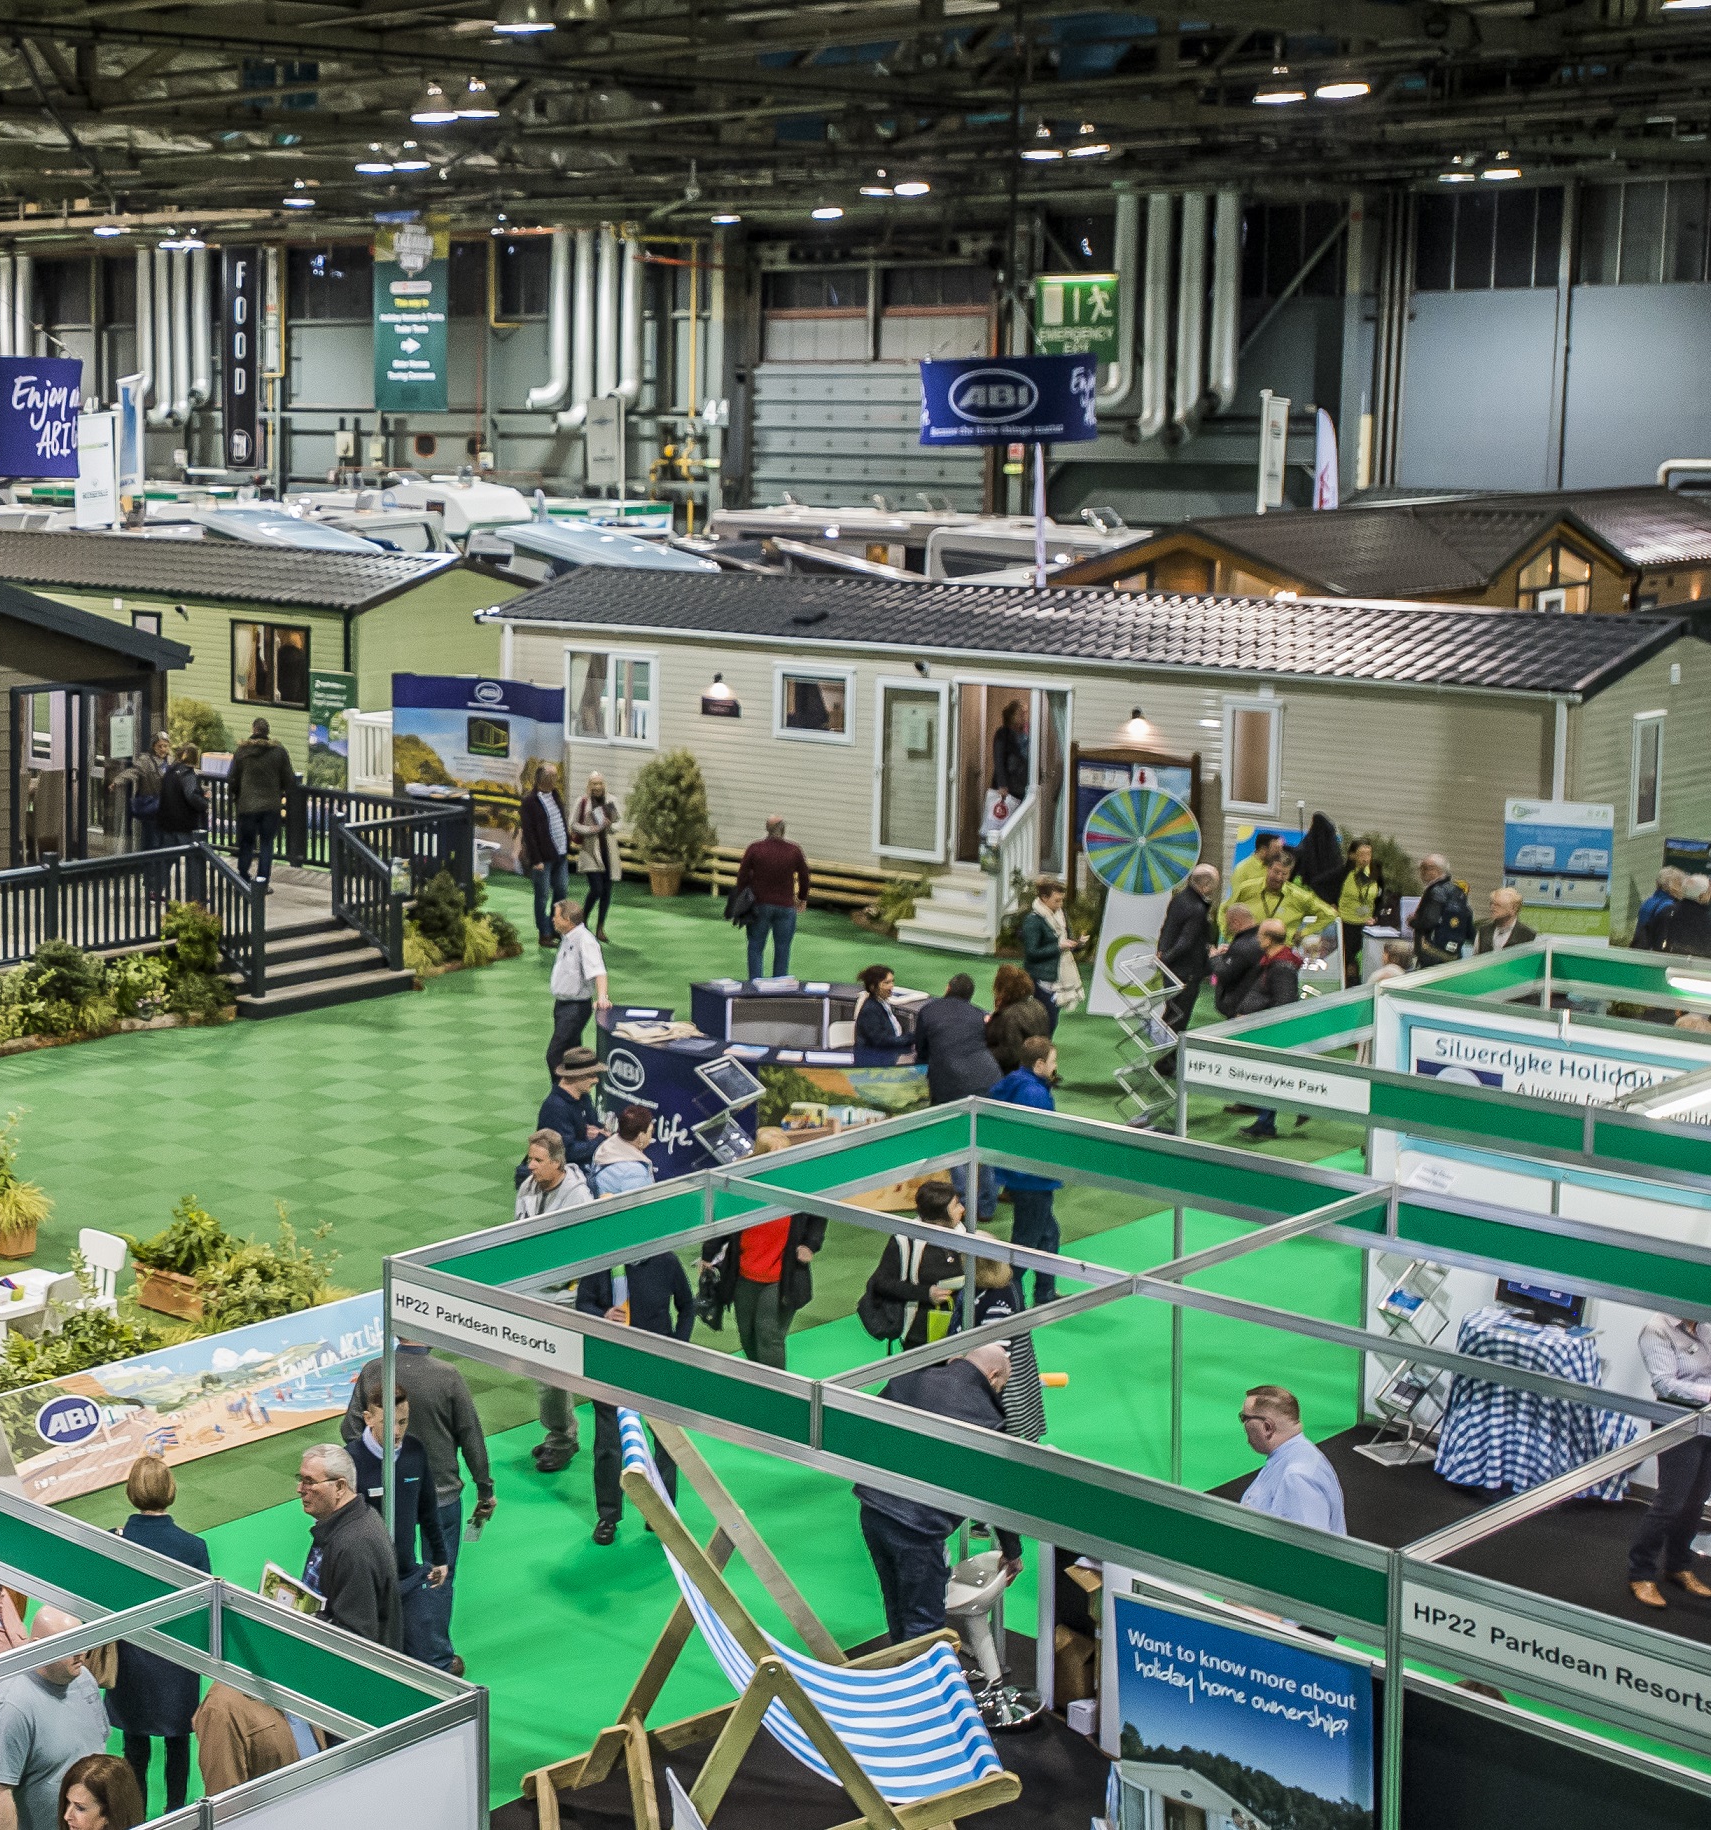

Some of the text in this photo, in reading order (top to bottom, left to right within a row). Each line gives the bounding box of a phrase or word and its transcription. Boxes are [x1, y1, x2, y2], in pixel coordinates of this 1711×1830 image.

[234, 260, 247, 395] FOOD
[11, 375, 67, 431] Enjoy
[957, 384, 1030, 409] ABI
[35, 420, 72, 460] ABI
[1188, 1059, 1328, 1095] HP12 Silverdyke Park
[1435, 1038, 1652, 1088] Silverdyke Holiday
[1516, 1081, 1526, 1095] A
[395, 1293, 557, 1354] HP22 Parkdean Resorts
[278, 1354, 322, 1390] Enjoy
[47, 1404, 98, 1437] ABI
[1127, 1628, 1357, 1710] Want to know more about
[1414, 1602, 1711, 1716] HP22 Parkdean Resorts
[1135, 1651, 1349, 1740] holiday home ownership?
